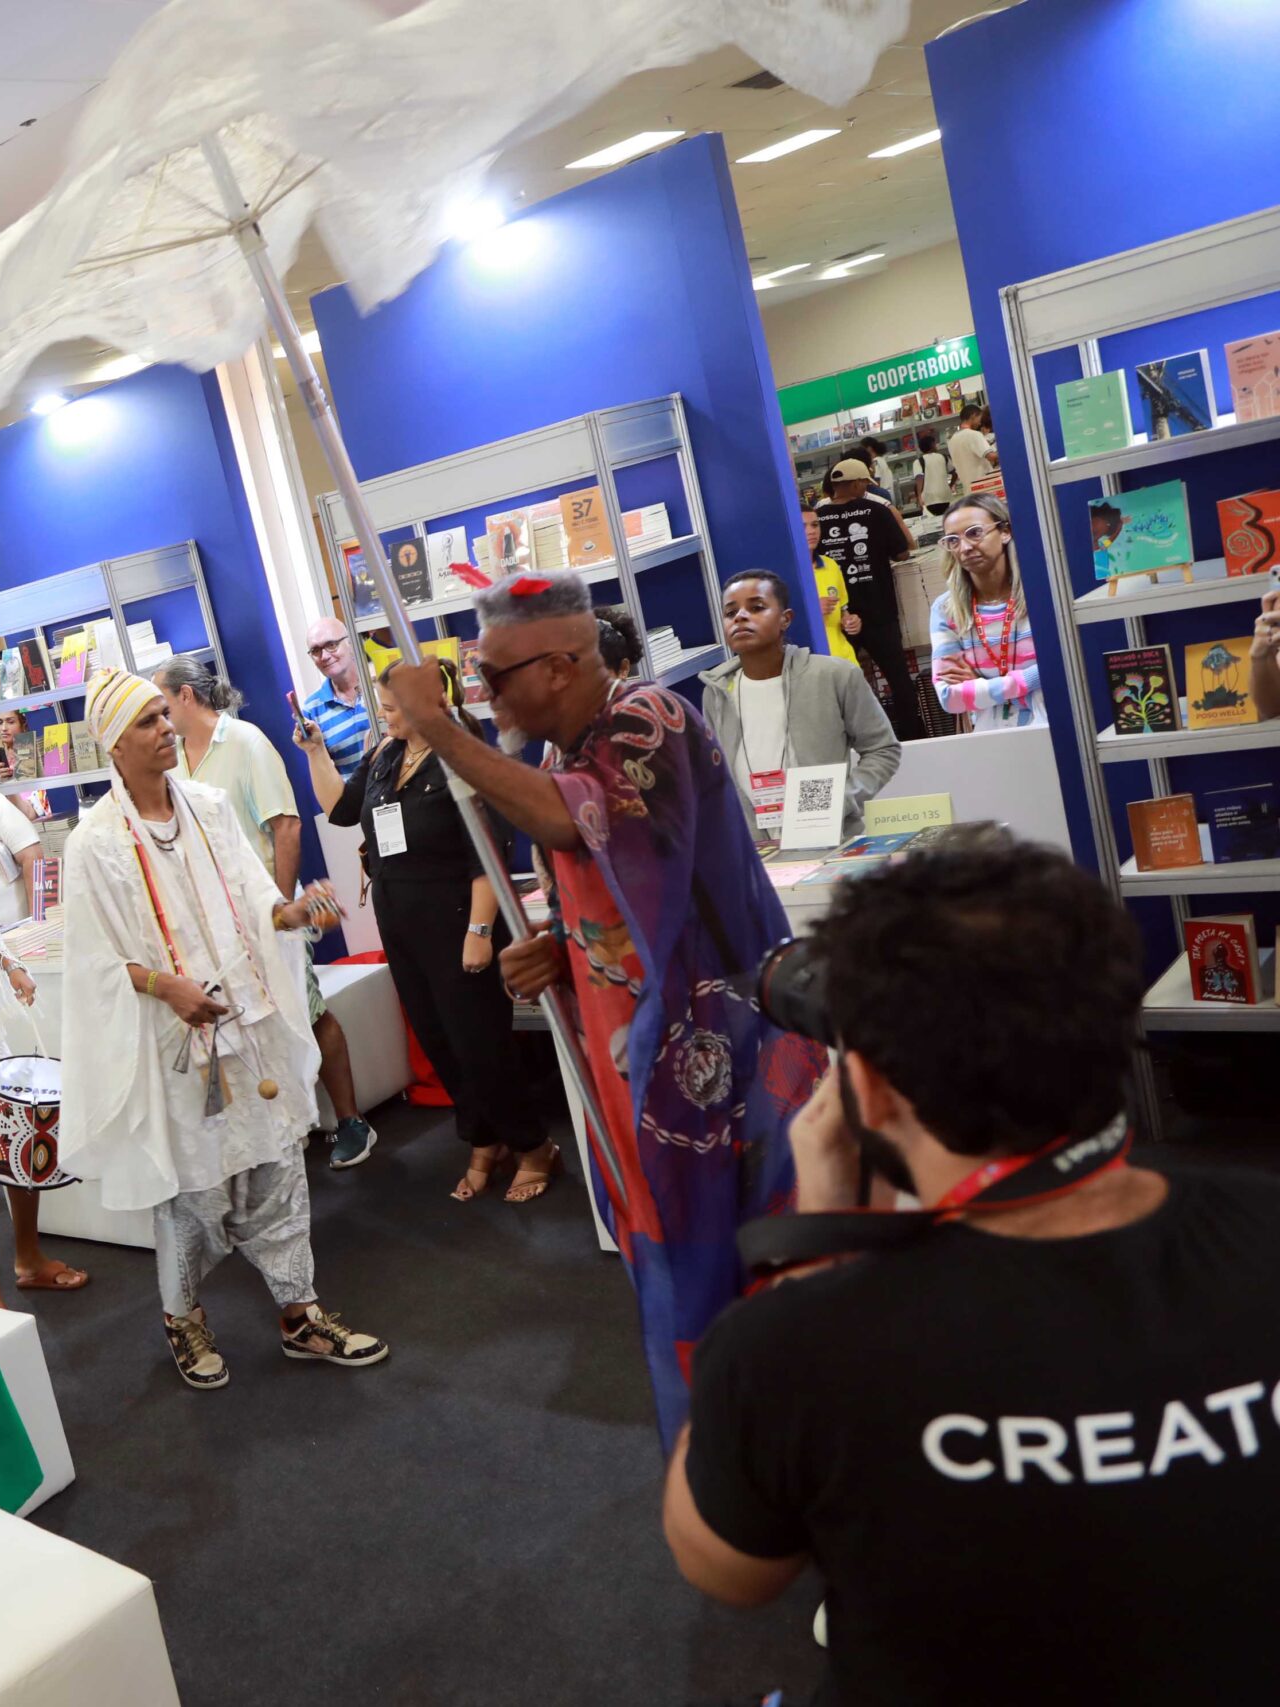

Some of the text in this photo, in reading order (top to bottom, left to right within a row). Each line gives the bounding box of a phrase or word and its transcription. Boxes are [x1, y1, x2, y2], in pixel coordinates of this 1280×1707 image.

[867, 347, 972, 393] COOPERBOOK
[571, 498, 593, 521] 37
[841, 508, 872, 519] ajudar?
[922, 1380, 1280, 1484] CREAT
